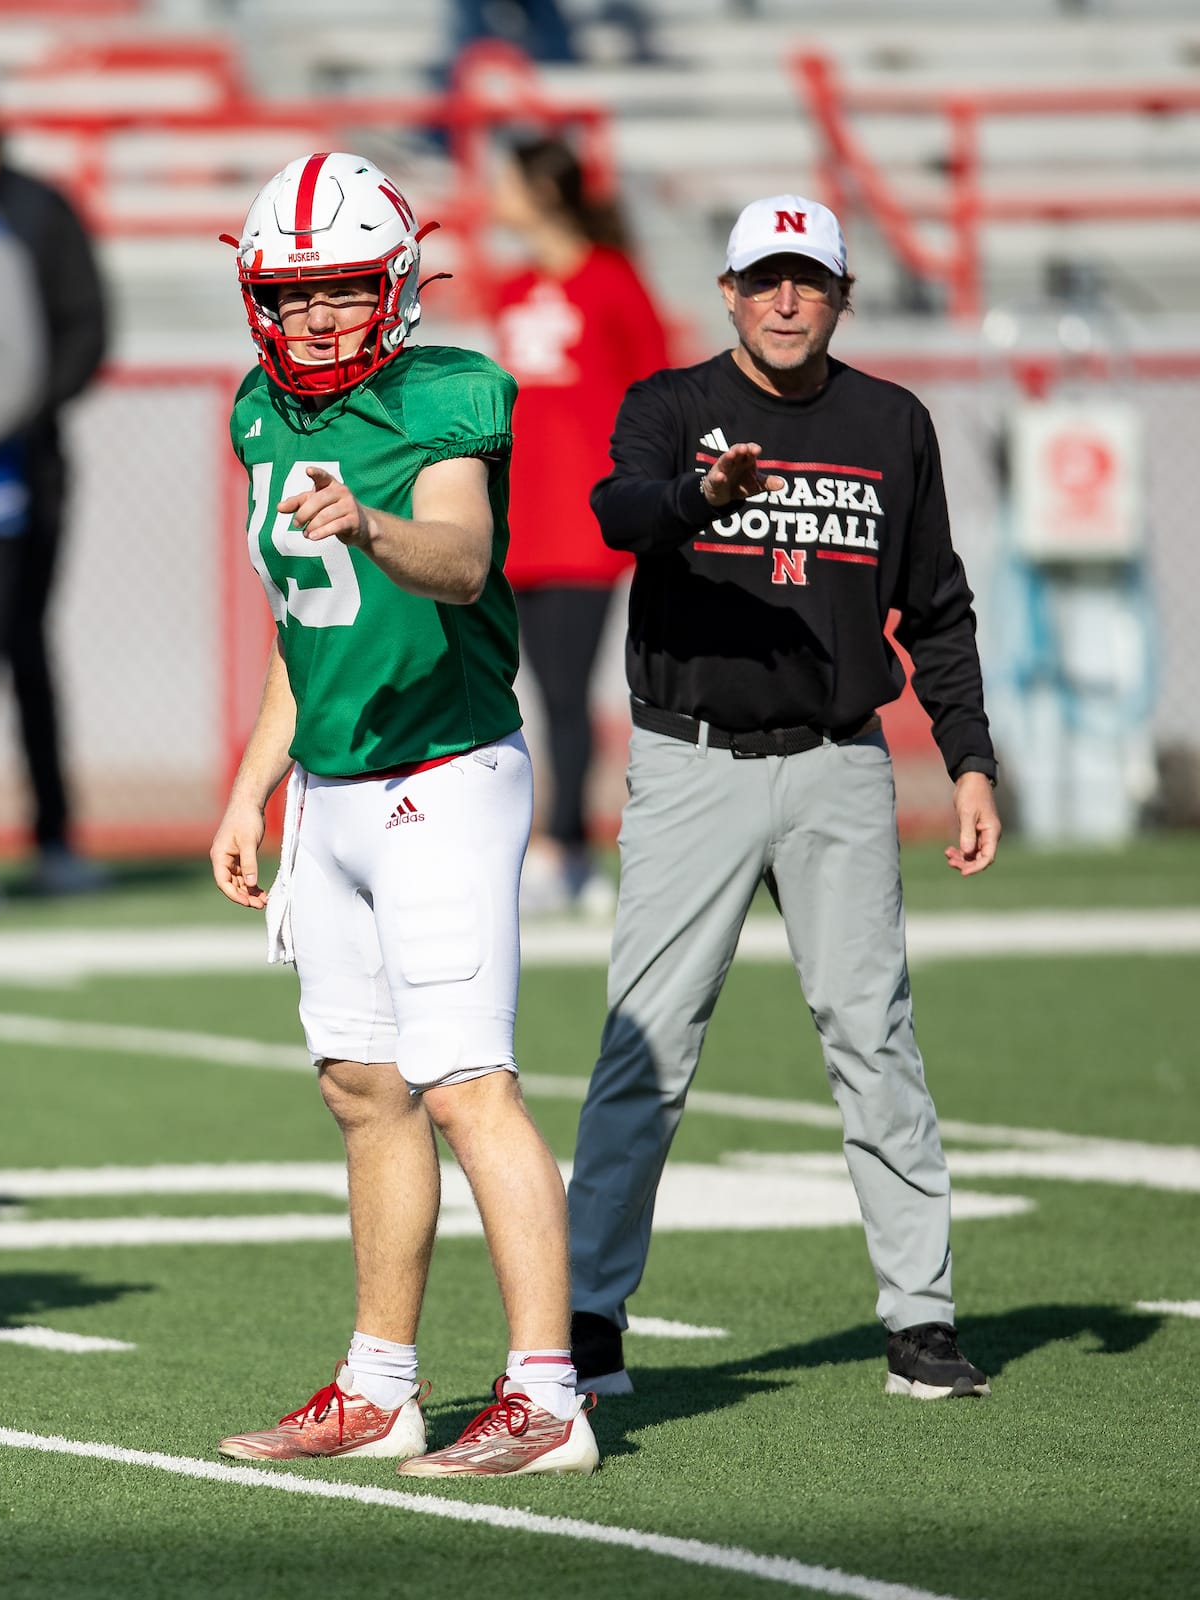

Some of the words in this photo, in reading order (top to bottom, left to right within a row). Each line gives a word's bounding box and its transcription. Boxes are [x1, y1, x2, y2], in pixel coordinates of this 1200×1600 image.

[774, 210, 807, 234] N
[287, 251, 320, 263] HUSKERS
[695, 468, 884, 515] RASKA
[247, 461, 361, 628] 19
[699, 508, 879, 550] OOTBALL
[771, 547, 808, 586] N
[385, 812, 425, 829] adidas
